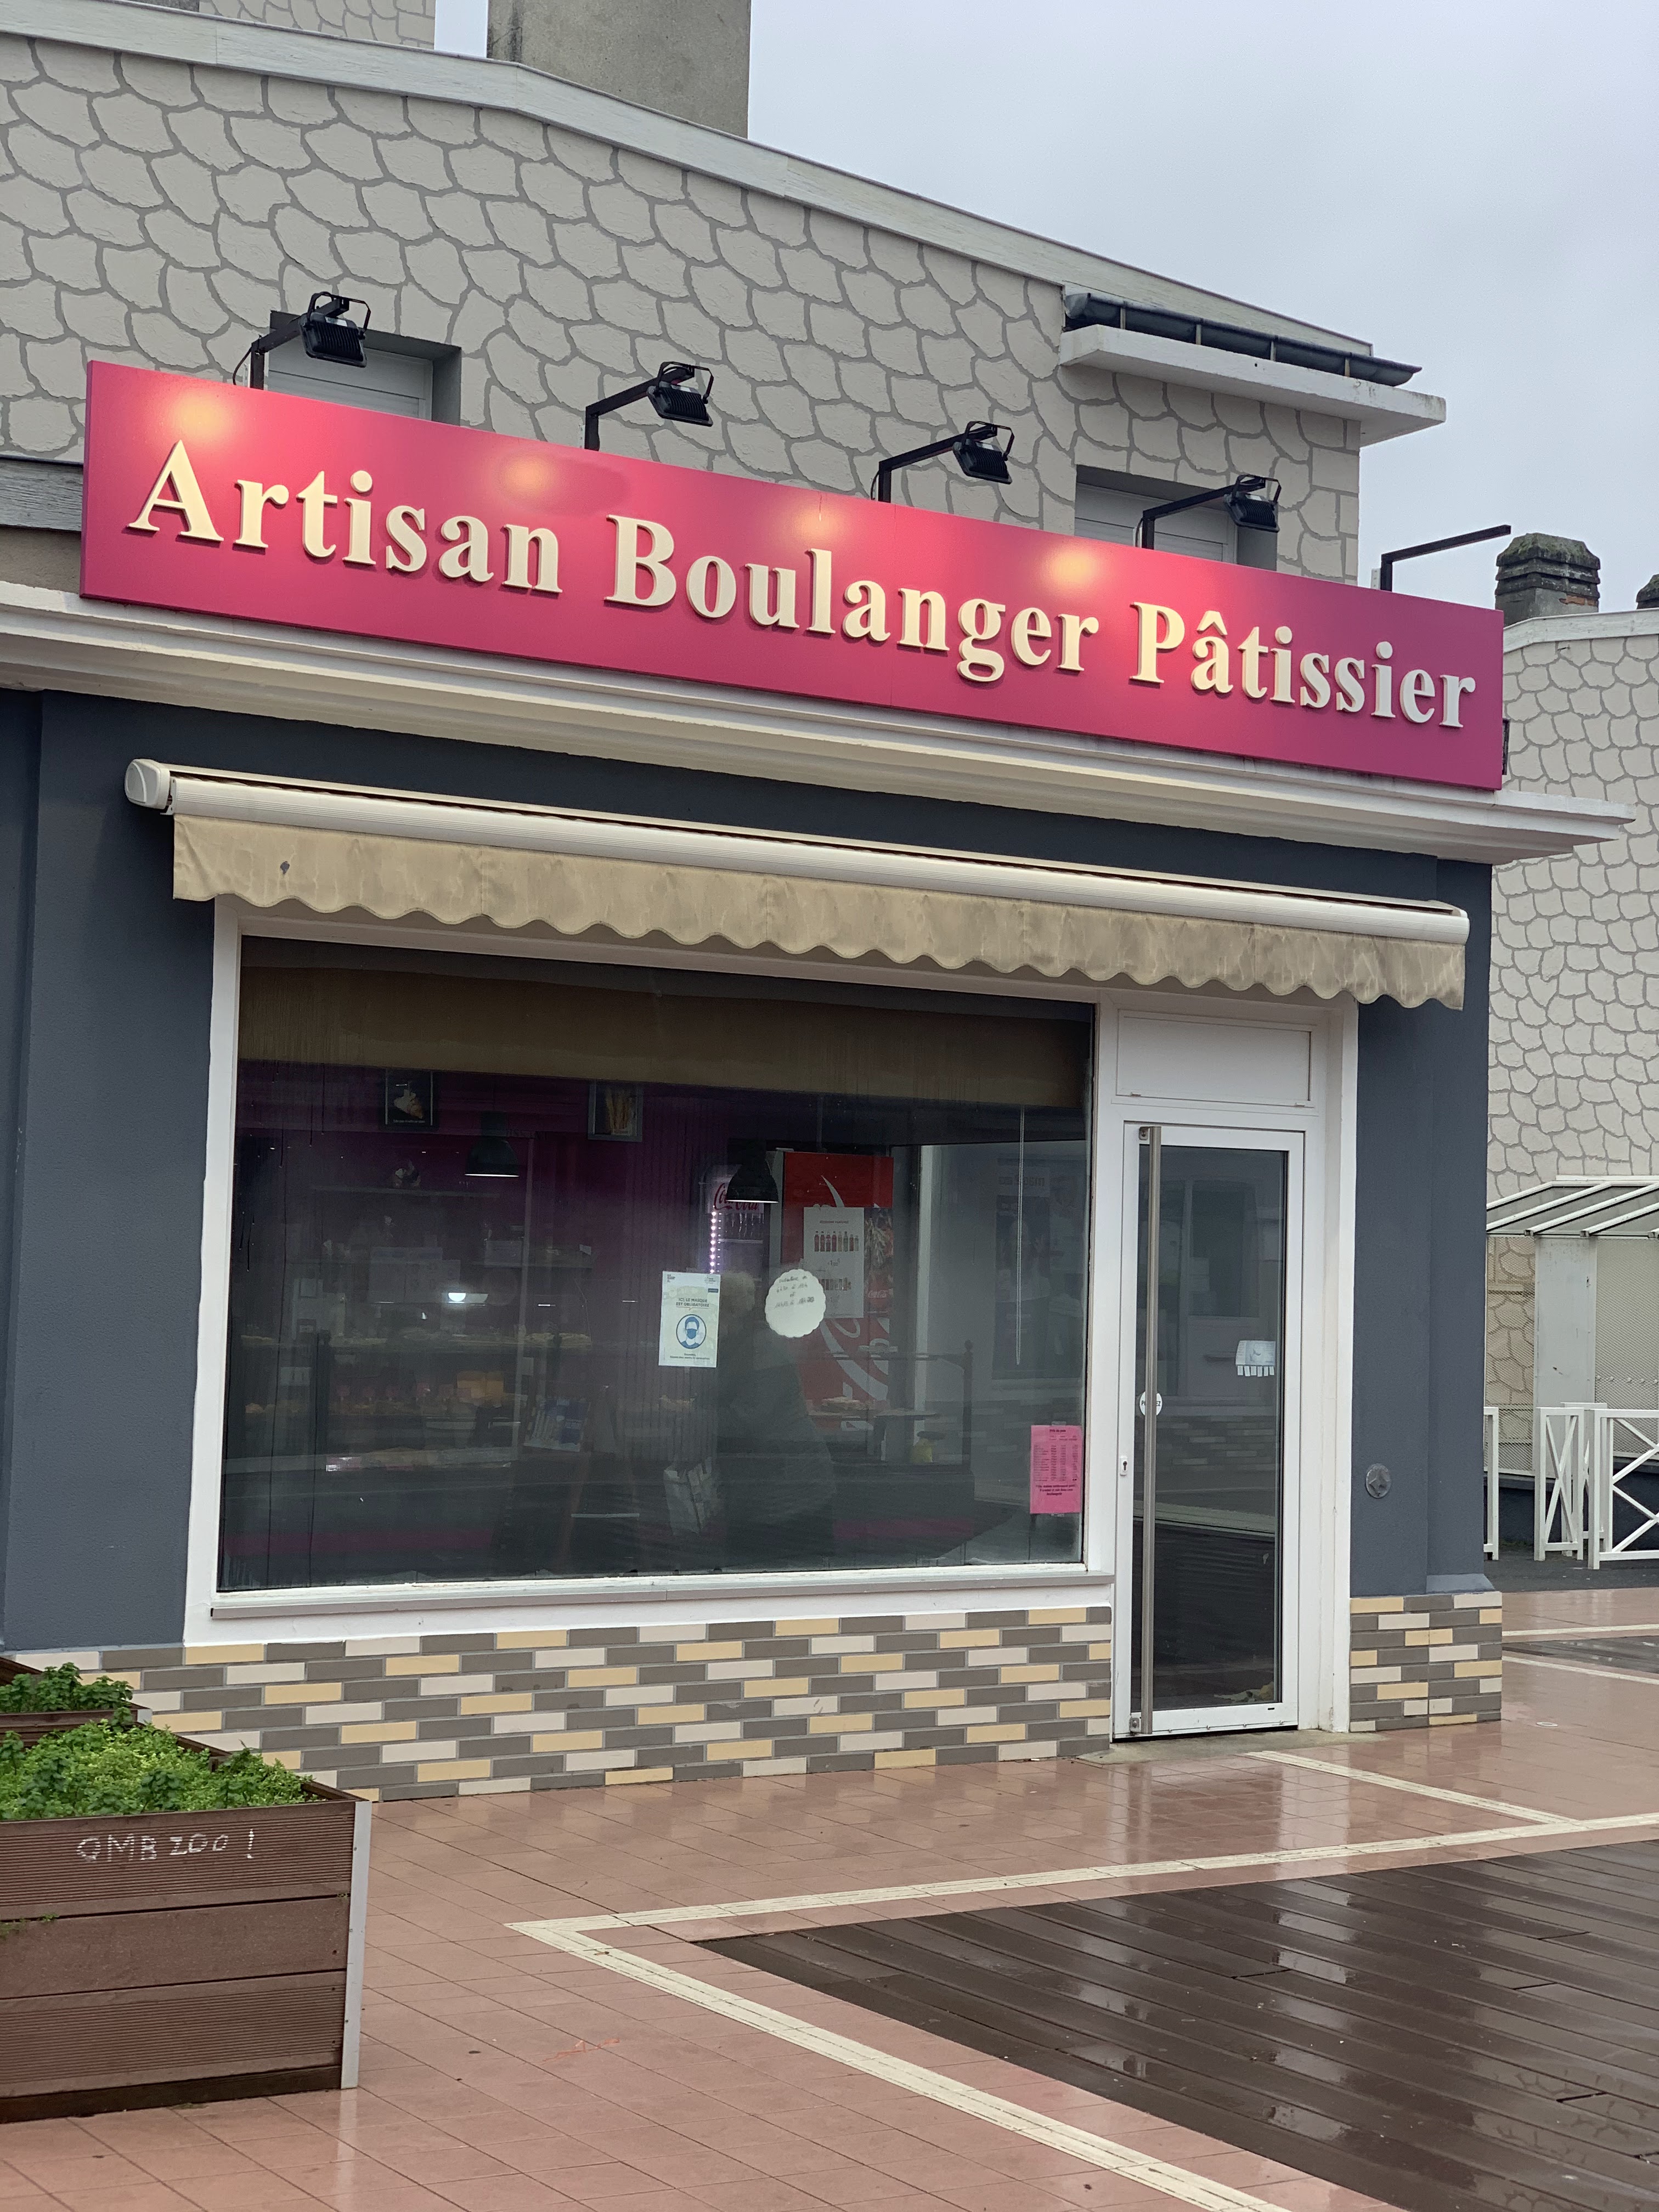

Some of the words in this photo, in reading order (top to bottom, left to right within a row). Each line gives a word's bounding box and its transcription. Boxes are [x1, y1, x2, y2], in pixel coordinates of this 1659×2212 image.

[126, 438, 563, 594] Artisan
[603, 514, 1101, 682] Boulanger
[1129, 601, 1477, 729] Pâtissier
